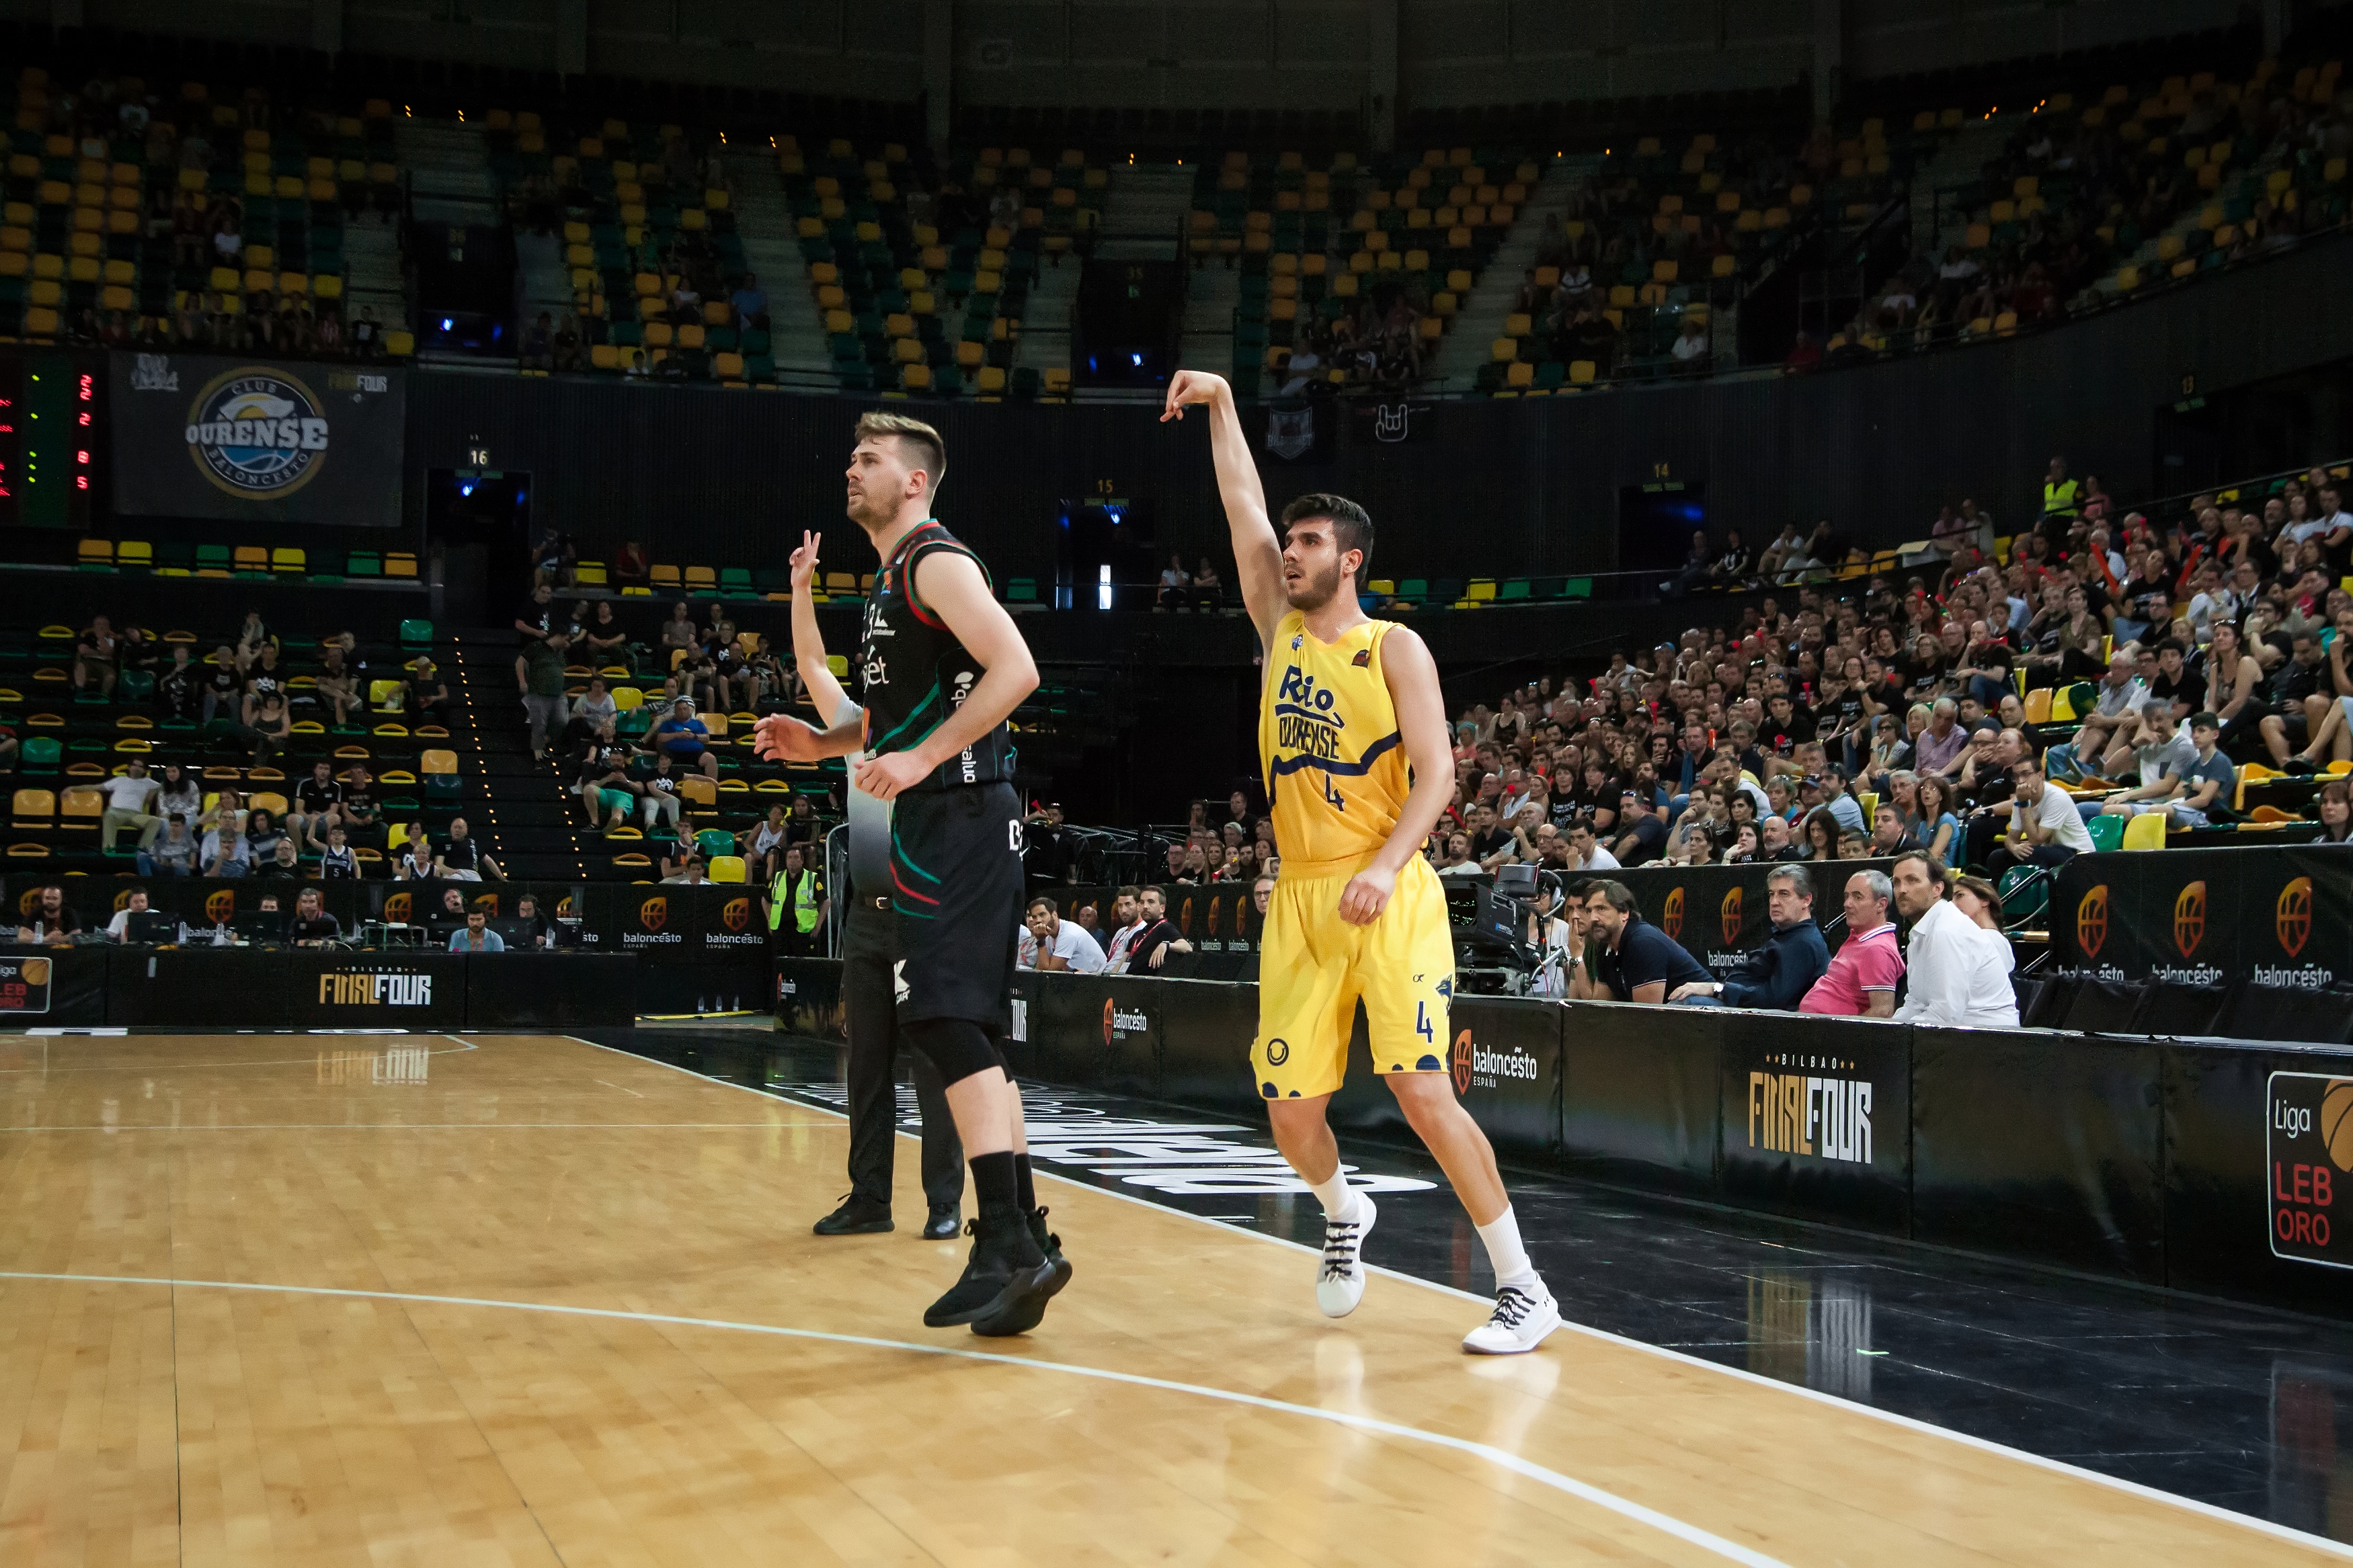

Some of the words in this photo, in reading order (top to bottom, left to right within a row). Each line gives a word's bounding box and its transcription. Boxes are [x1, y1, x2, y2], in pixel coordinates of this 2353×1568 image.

[185, 417, 328, 451] OURENSE
[208, 449, 309, 485] BALONCESTO
[471, 449, 487, 465] 16
[1098, 479, 1113, 493] 15
[1279, 716, 1340, 759] OURENSE
[1325, 773, 1345, 812] 4
[1417, 1001, 1433, 1043] 4
[1782, 1054, 1837, 1069] BILBAO
[1473, 1075, 1497, 1088] ESPAÑA
[2275, 1099, 2311, 1139] Liga
[2276, 1161, 2333, 1206] LEB
[2276, 1208, 2331, 1247] ORO
